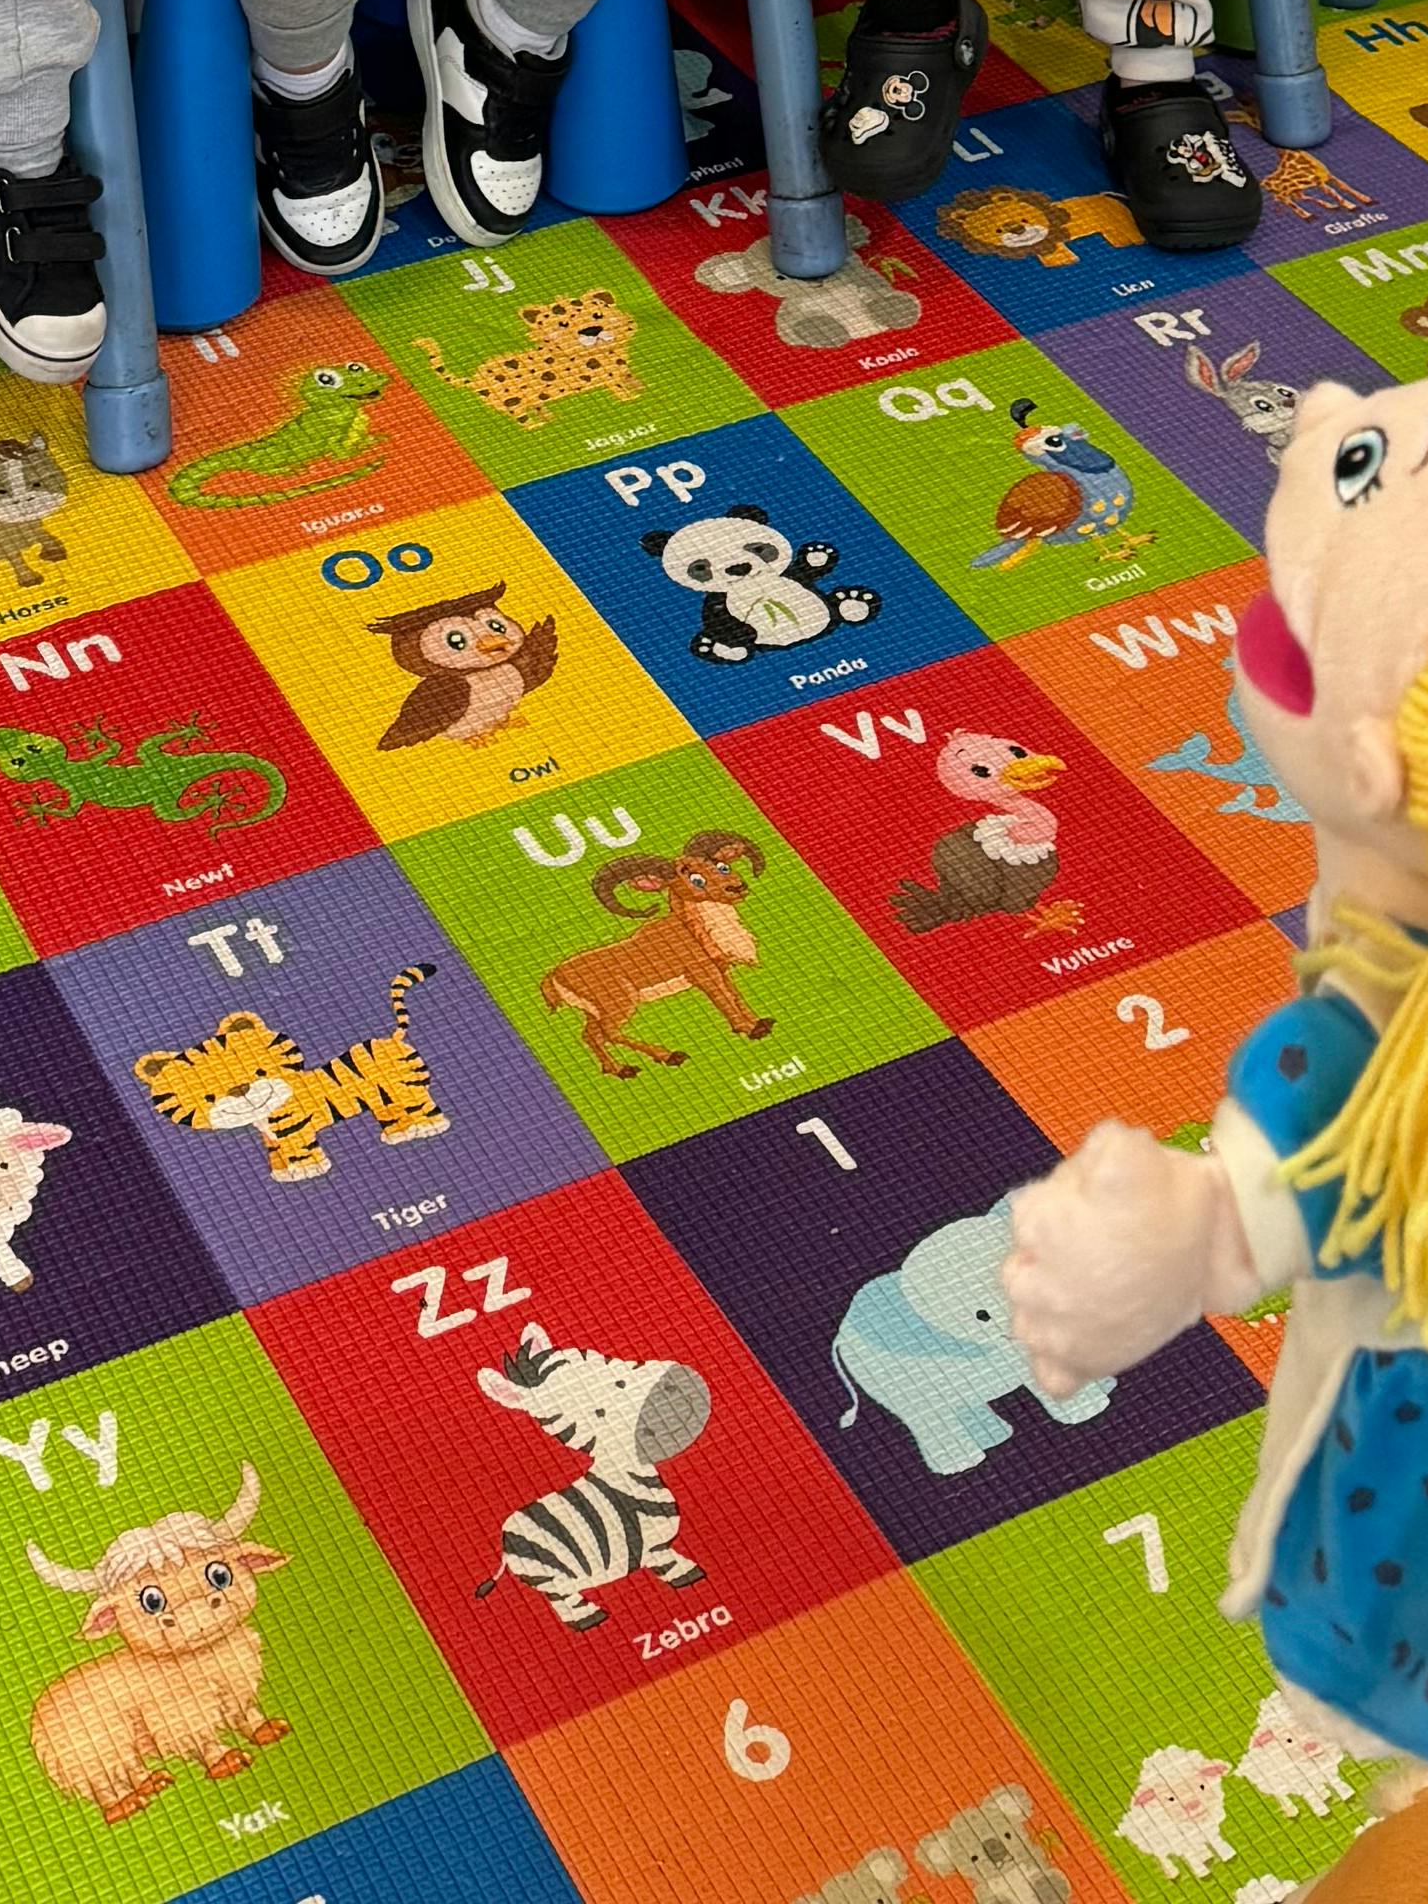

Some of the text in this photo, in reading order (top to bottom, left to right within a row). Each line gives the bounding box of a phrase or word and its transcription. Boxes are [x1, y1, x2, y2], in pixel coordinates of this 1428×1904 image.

[1324, 209, 1390, 238] Giraffe
[461, 255, 517, 294] Jj
[1112, 278, 1155, 300] Lion
[1133, 304, 1214, 349] Rr
[857, 344, 921, 372] Koala
[879, 377, 997, 424] Qq
[583, 421, 659, 452] Jaguar
[604, 457, 707, 507] Pp
[299, 500, 386, 537] Iguana
[320, 542, 434, 591] Oo
[1085, 564, 1148, 593] Quail
[1088, 603, 1239, 670] Ww
[788, 654, 870, 692] Panda
[820, 707, 928, 761] Vv
[507, 755, 562, 784] Owl
[512, 805, 643, 868] Uu
[162, 861, 236, 900] Newt
[188, 917, 285, 978] Tt
[1040, 935, 1136, 977] Vulture
[1116, 993, 1191, 1051] 2
[739, 1055, 807, 1095] Urial
[795, 1116, 858, 1172] 1
[371, 1192, 450, 1234] Tiger
[390, 1254, 533, 1339] Zz
[1103, 1511, 1171, 1593] 7
[632, 1603, 735, 1663] Zebra
[723, 1696, 792, 1784] 6
[217, 1798, 291, 1843] Yak
